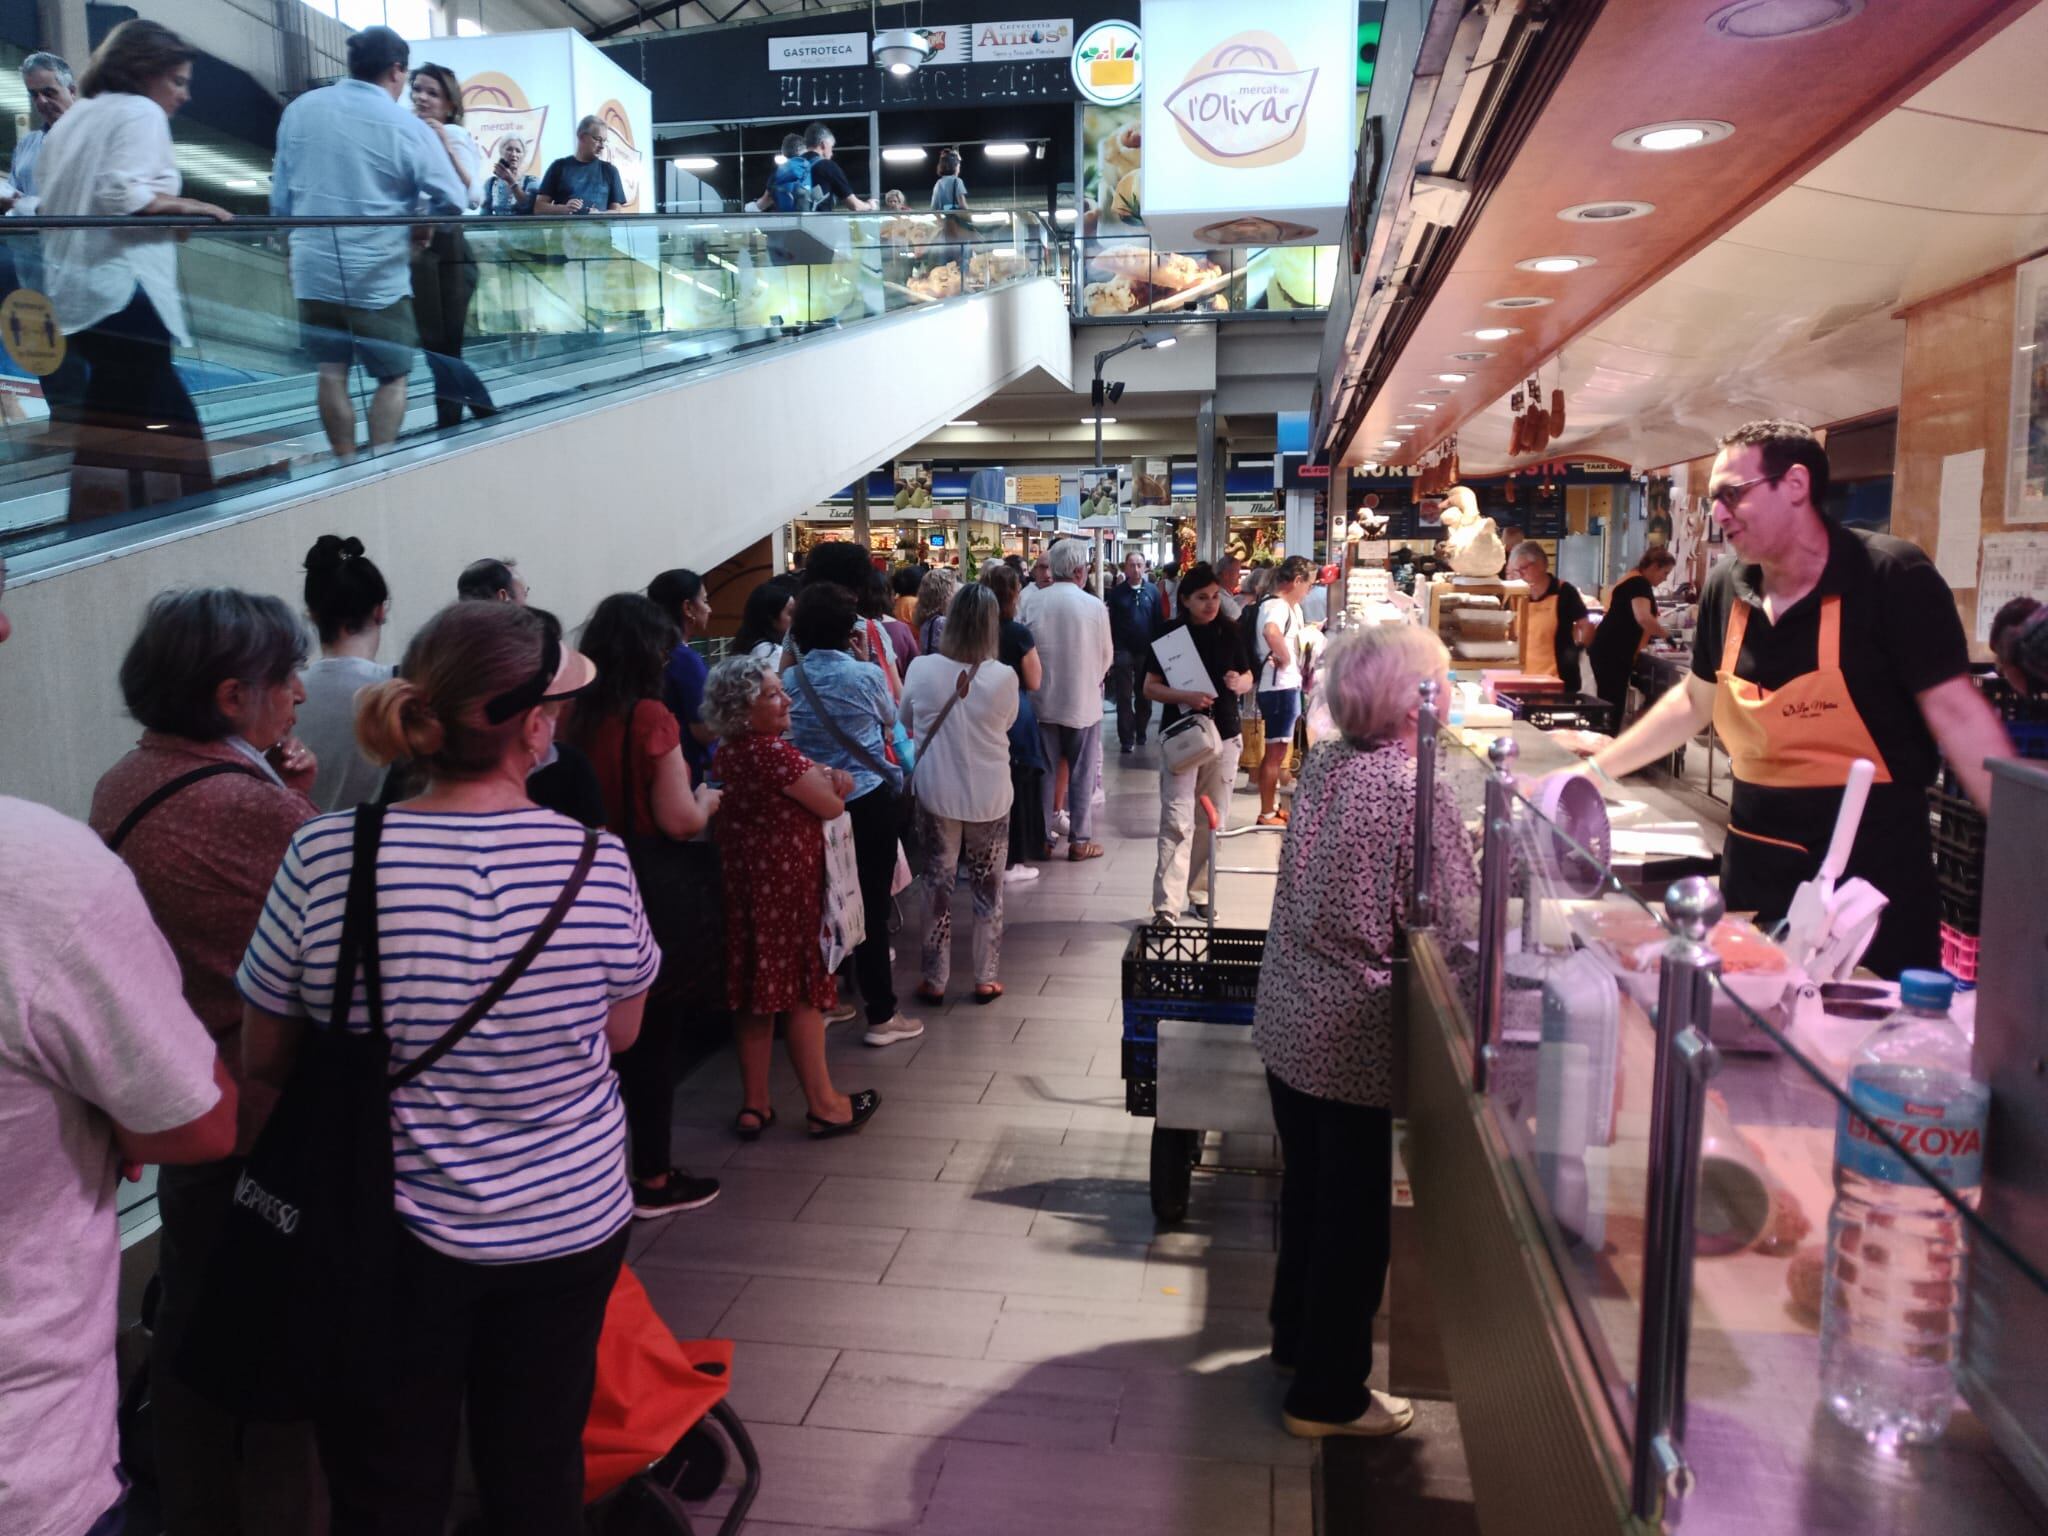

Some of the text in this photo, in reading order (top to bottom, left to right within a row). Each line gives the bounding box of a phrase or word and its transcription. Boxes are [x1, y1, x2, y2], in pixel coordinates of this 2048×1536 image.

[783, 45, 853, 57] GASTROTECA
[1239, 85, 1278, 95] mercat
[1188, 93, 1299, 125] l'Olivar
[480, 121, 514, 132] mercat
[1847, 1113, 1981, 1157] BEZOYA
[232, 1167, 299, 1234] NESPRESSO
